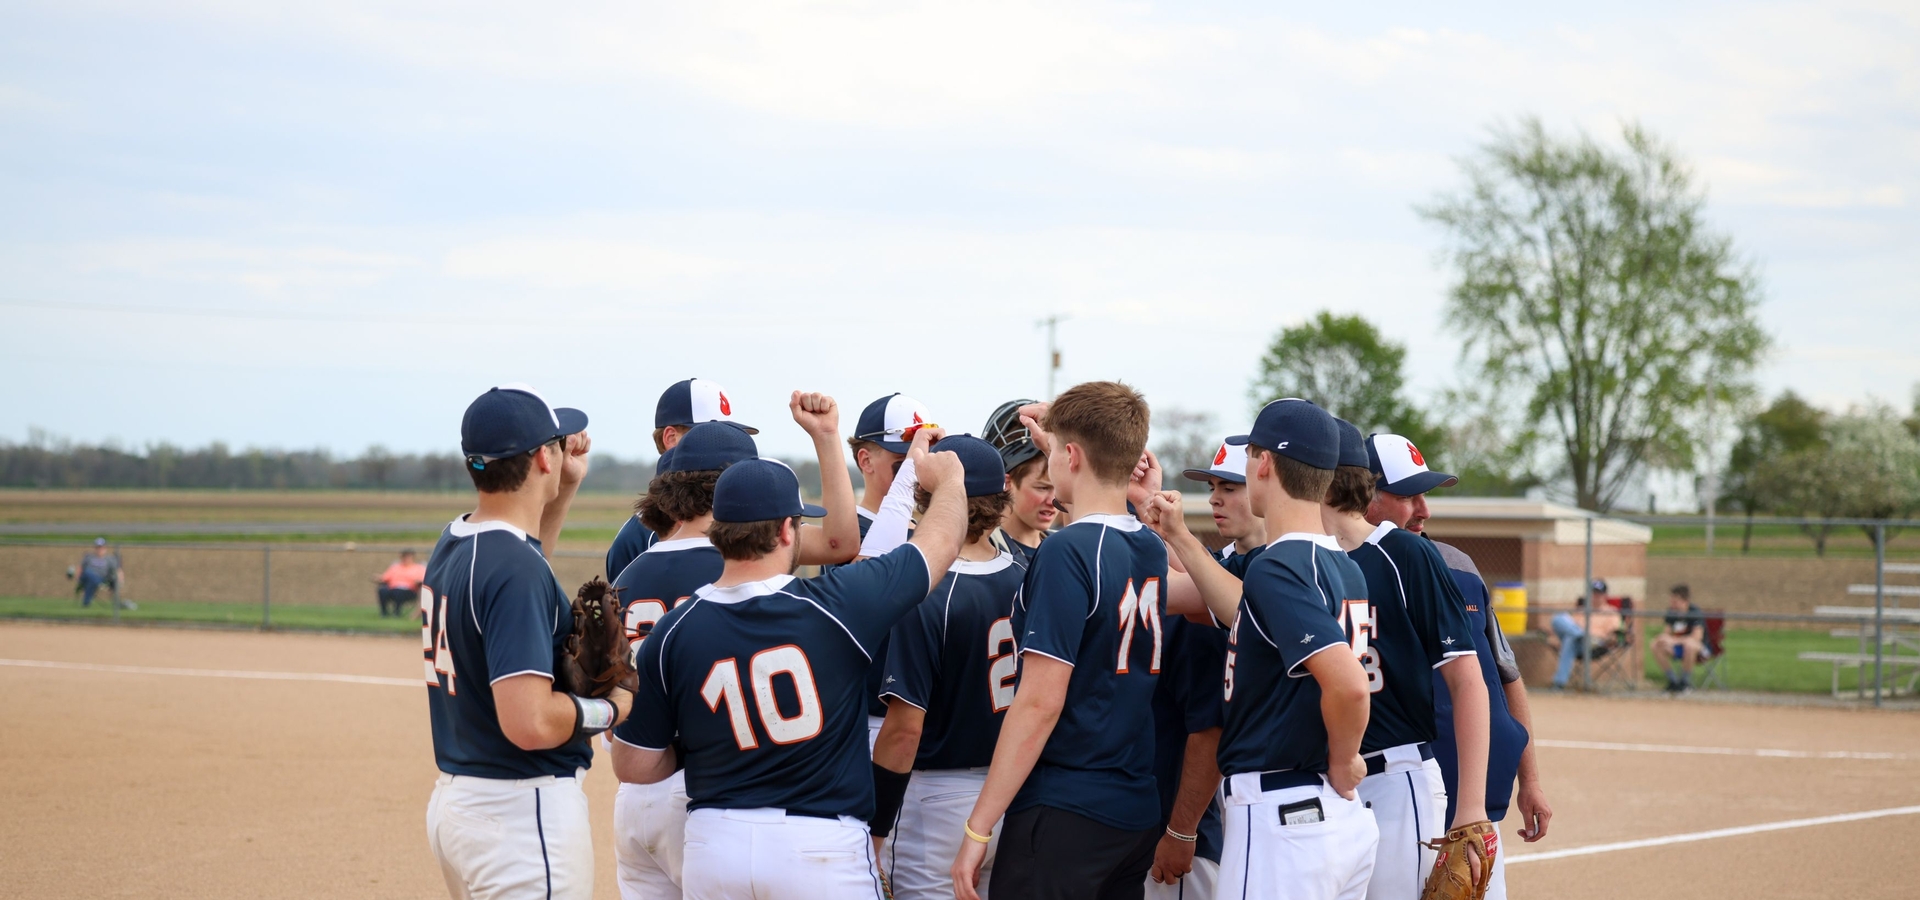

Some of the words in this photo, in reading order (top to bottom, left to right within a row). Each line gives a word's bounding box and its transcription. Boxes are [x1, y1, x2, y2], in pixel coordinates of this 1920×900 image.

[421, 584, 457, 696] 24
[1116, 577, 1163, 674] 11
[700, 643, 824, 751] 10
